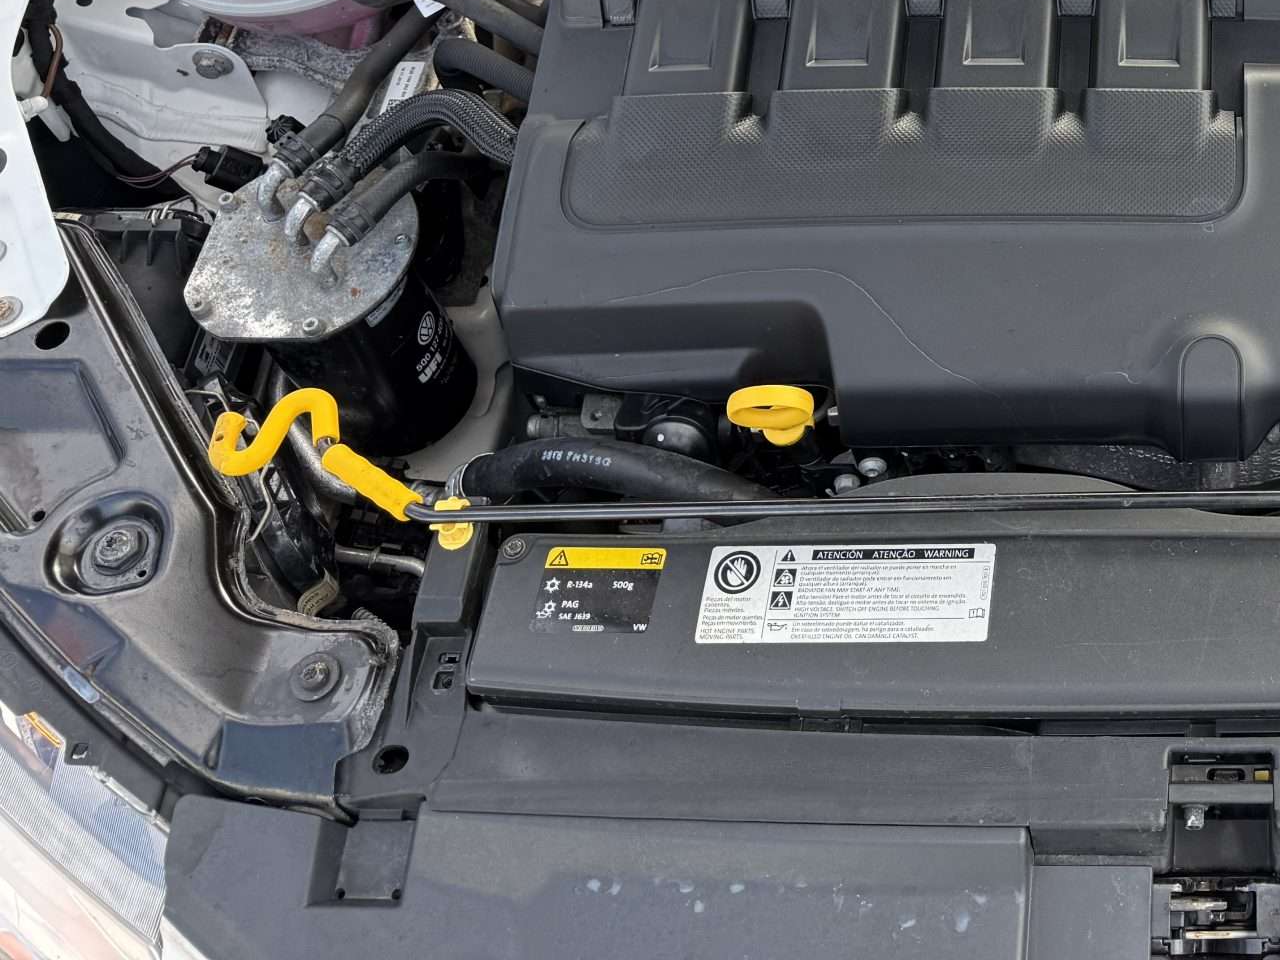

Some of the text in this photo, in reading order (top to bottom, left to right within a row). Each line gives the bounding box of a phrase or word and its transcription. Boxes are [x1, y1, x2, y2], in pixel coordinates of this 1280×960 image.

[418, 352, 442, 384] UFI
[924, 549, 969, 558] WARNING
[566, 581, 634, 590] R-134a 500g
[561, 600, 580, 608] PAG
